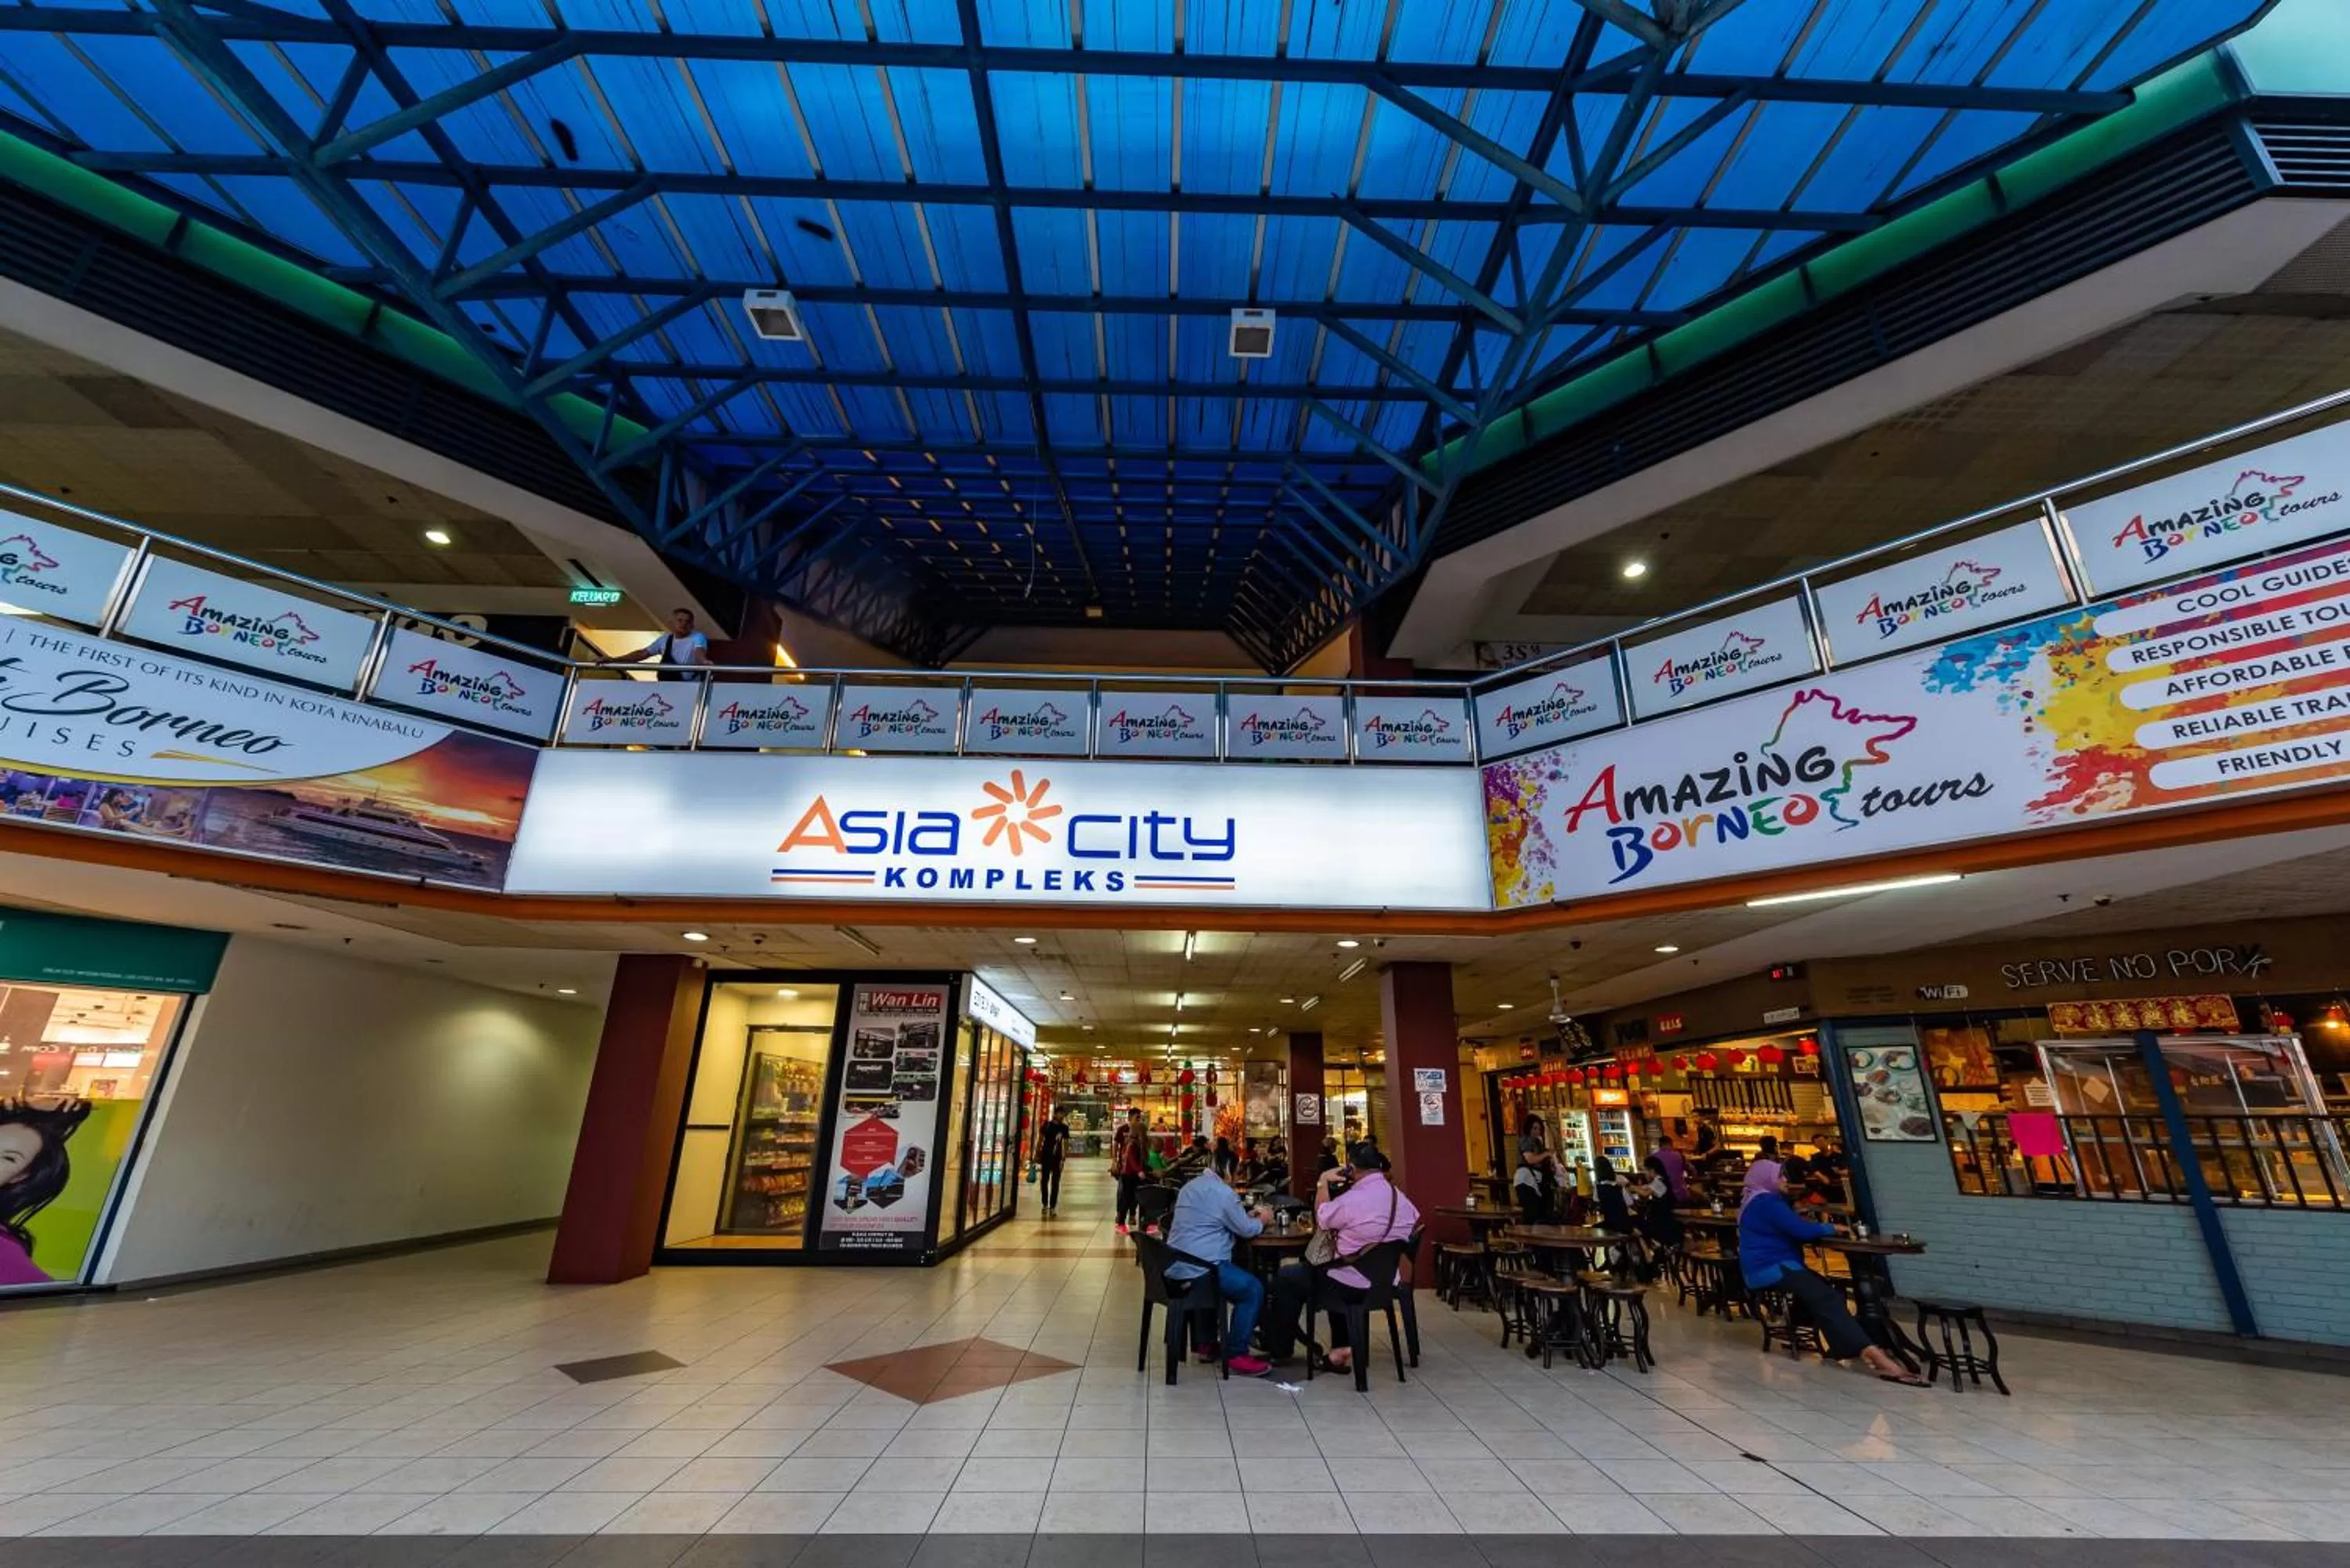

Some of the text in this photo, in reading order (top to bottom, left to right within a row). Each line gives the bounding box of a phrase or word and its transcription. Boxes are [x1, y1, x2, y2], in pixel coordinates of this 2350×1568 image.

[2279, 491, 2343, 516] tours
[2177, 558, 2350, 613] COOL GUIDE
[2131, 615, 2296, 664] RESPONSIBLE
[29, 633, 425, 739] THE FIRST OF ITS KIND IN KOTA KINABALU
[2167, 649, 2336, 697] AFFORDABLE
[2, 670, 296, 754] Borneo
[2173, 705, 2288, 739] RELIABLE
[2217, 739, 2341, 774] FRIENDLY
[1860, 771, 1994, 818] tours
[884, 867, 1125, 892] KOMPLEKS
[2001, 946, 2272, 988] SERVE NO PORK
[871, 992, 907, 1006] Wan
[911, 992, 939, 1007] Lin
